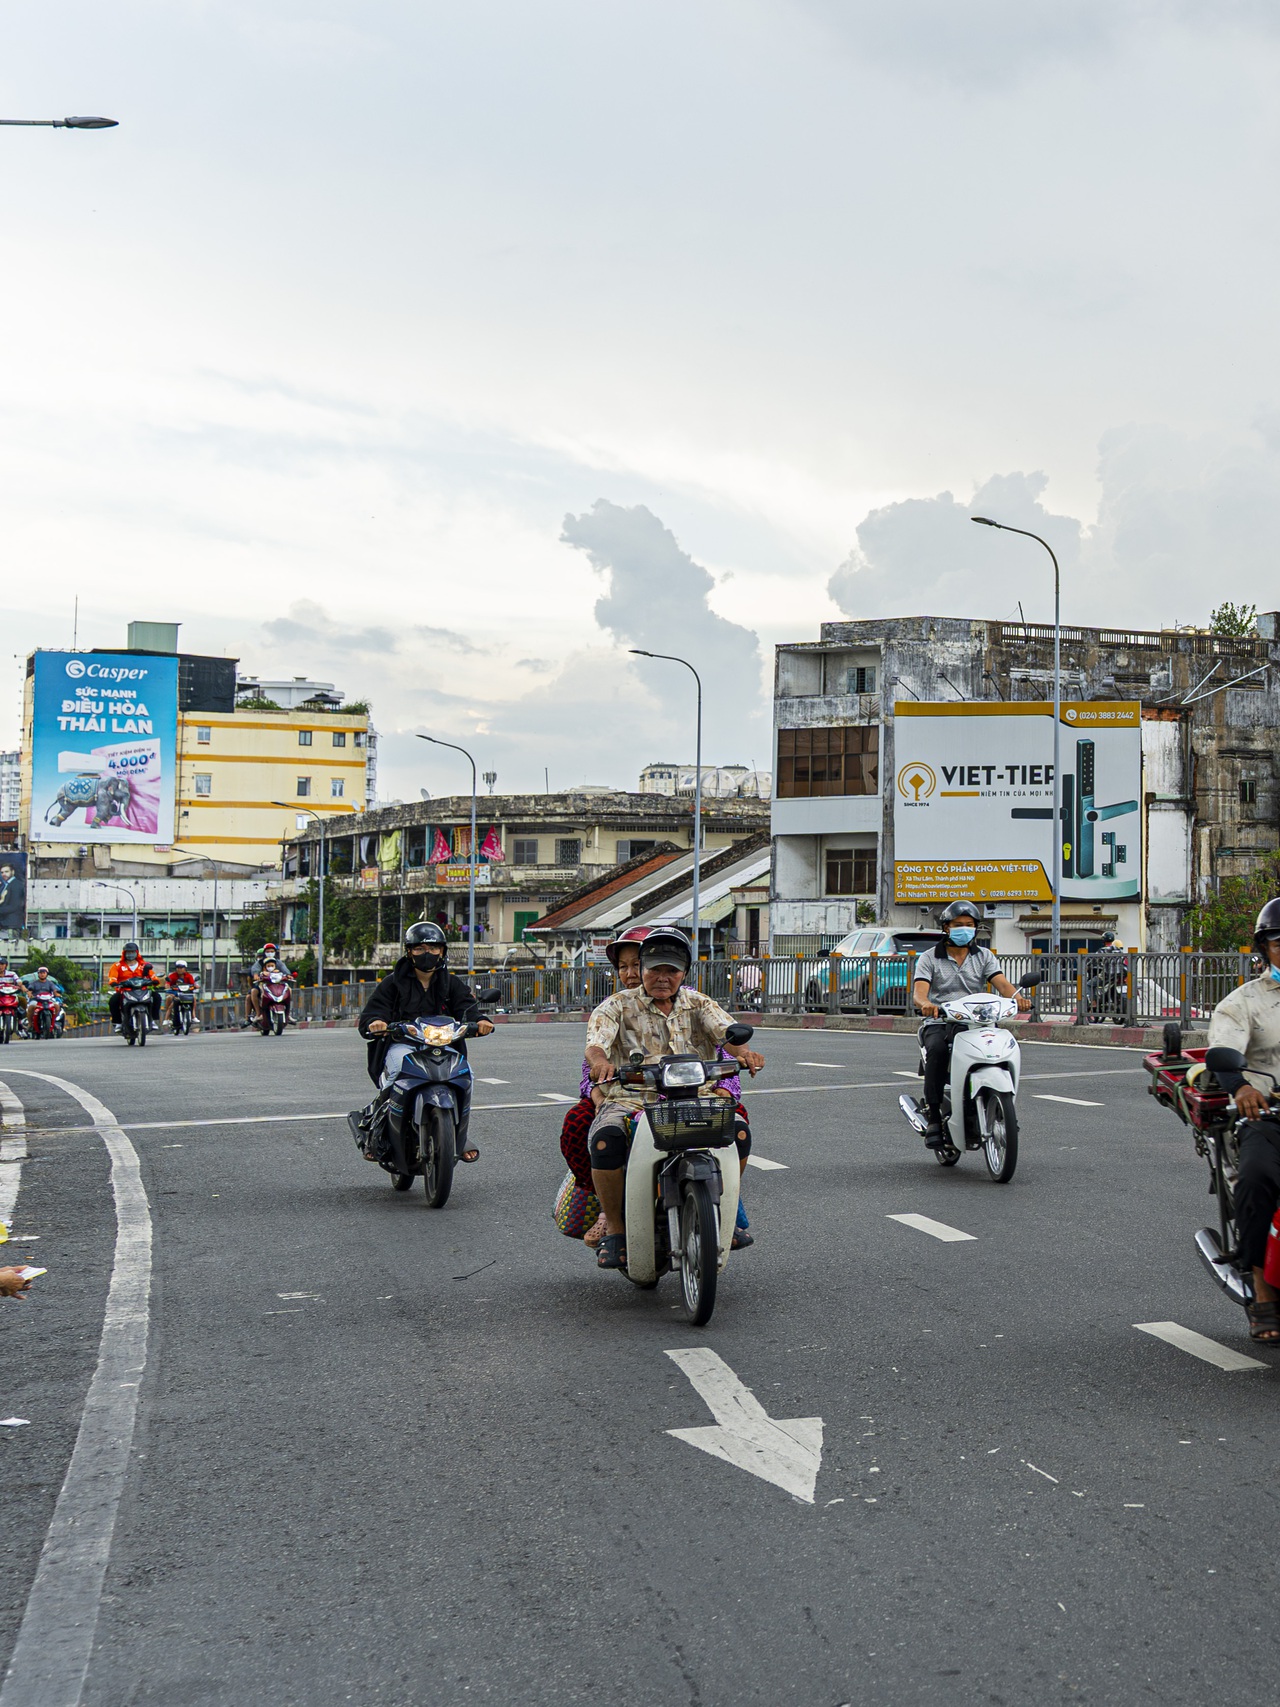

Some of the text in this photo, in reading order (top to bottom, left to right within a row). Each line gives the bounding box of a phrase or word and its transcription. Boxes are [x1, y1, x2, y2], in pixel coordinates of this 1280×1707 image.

[87, 664, 148, 682] Casper
[75, 686, 136, 699] SỨC MẠNH
[61, 696, 149, 716] ĐIỀU HÒA
[1079, 712, 1097, 720] (024)
[57, 714, 153, 734] THÁI LAN
[108, 754, 148, 769] 4.000
[941, 765, 1054, 786] VIET-TIEP
[897, 864, 922, 873] CÔNG
[975, 864, 999, 873] KHÓA
[1001, 864, 1039, 874] VIỆT-TIỆP
[990, 890, 1005, 898] (028)
